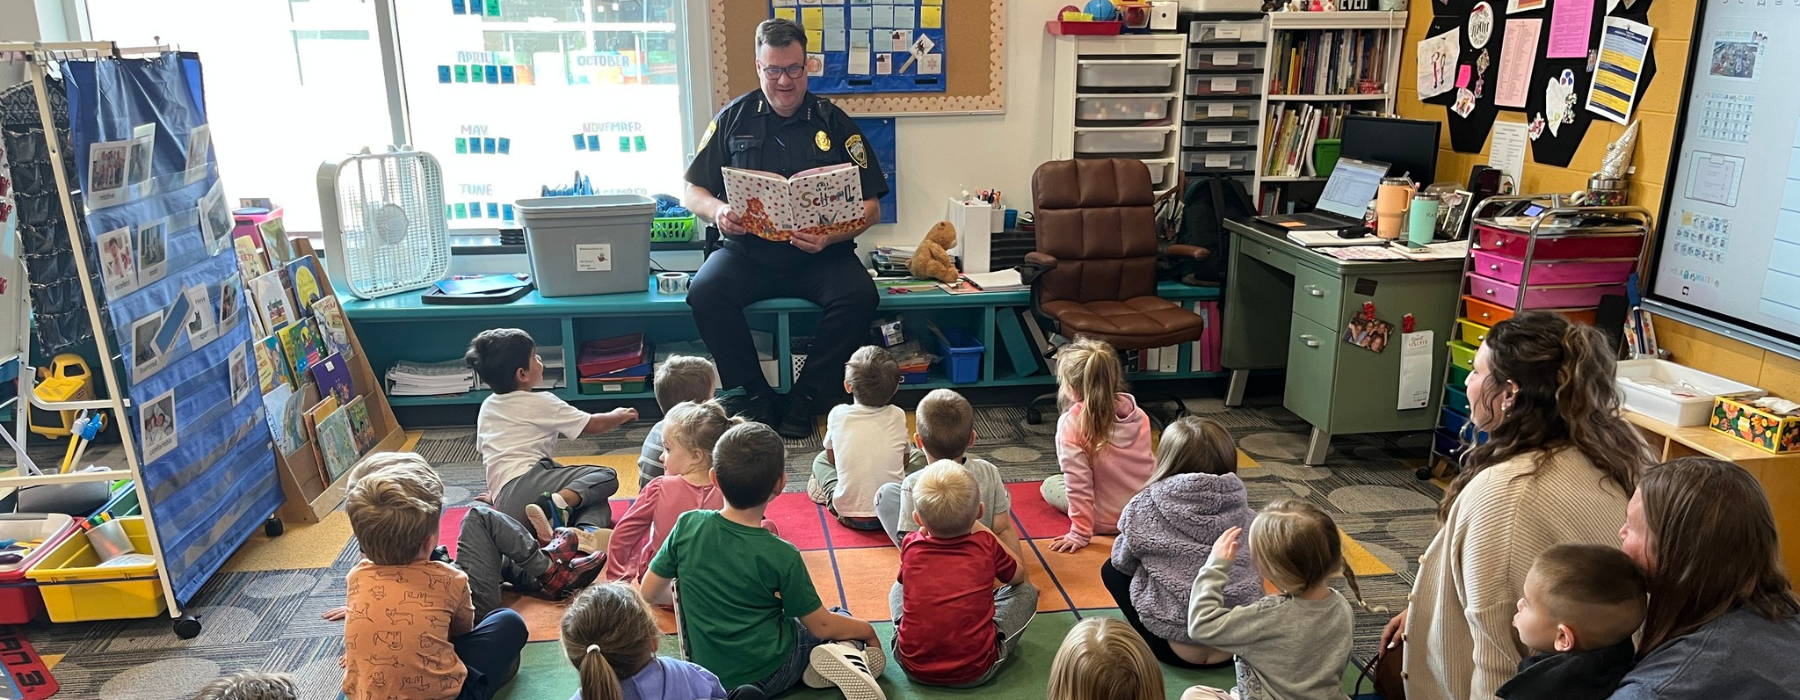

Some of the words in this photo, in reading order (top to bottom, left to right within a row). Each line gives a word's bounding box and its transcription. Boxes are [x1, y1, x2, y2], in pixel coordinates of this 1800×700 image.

[456, 51, 491, 63] APRIL
[577, 55, 630, 67] OCTOBER
[460, 124, 489, 136] MAY
[582, 121, 642, 133] NOVEMBER
[458, 183, 493, 196] JUNE
